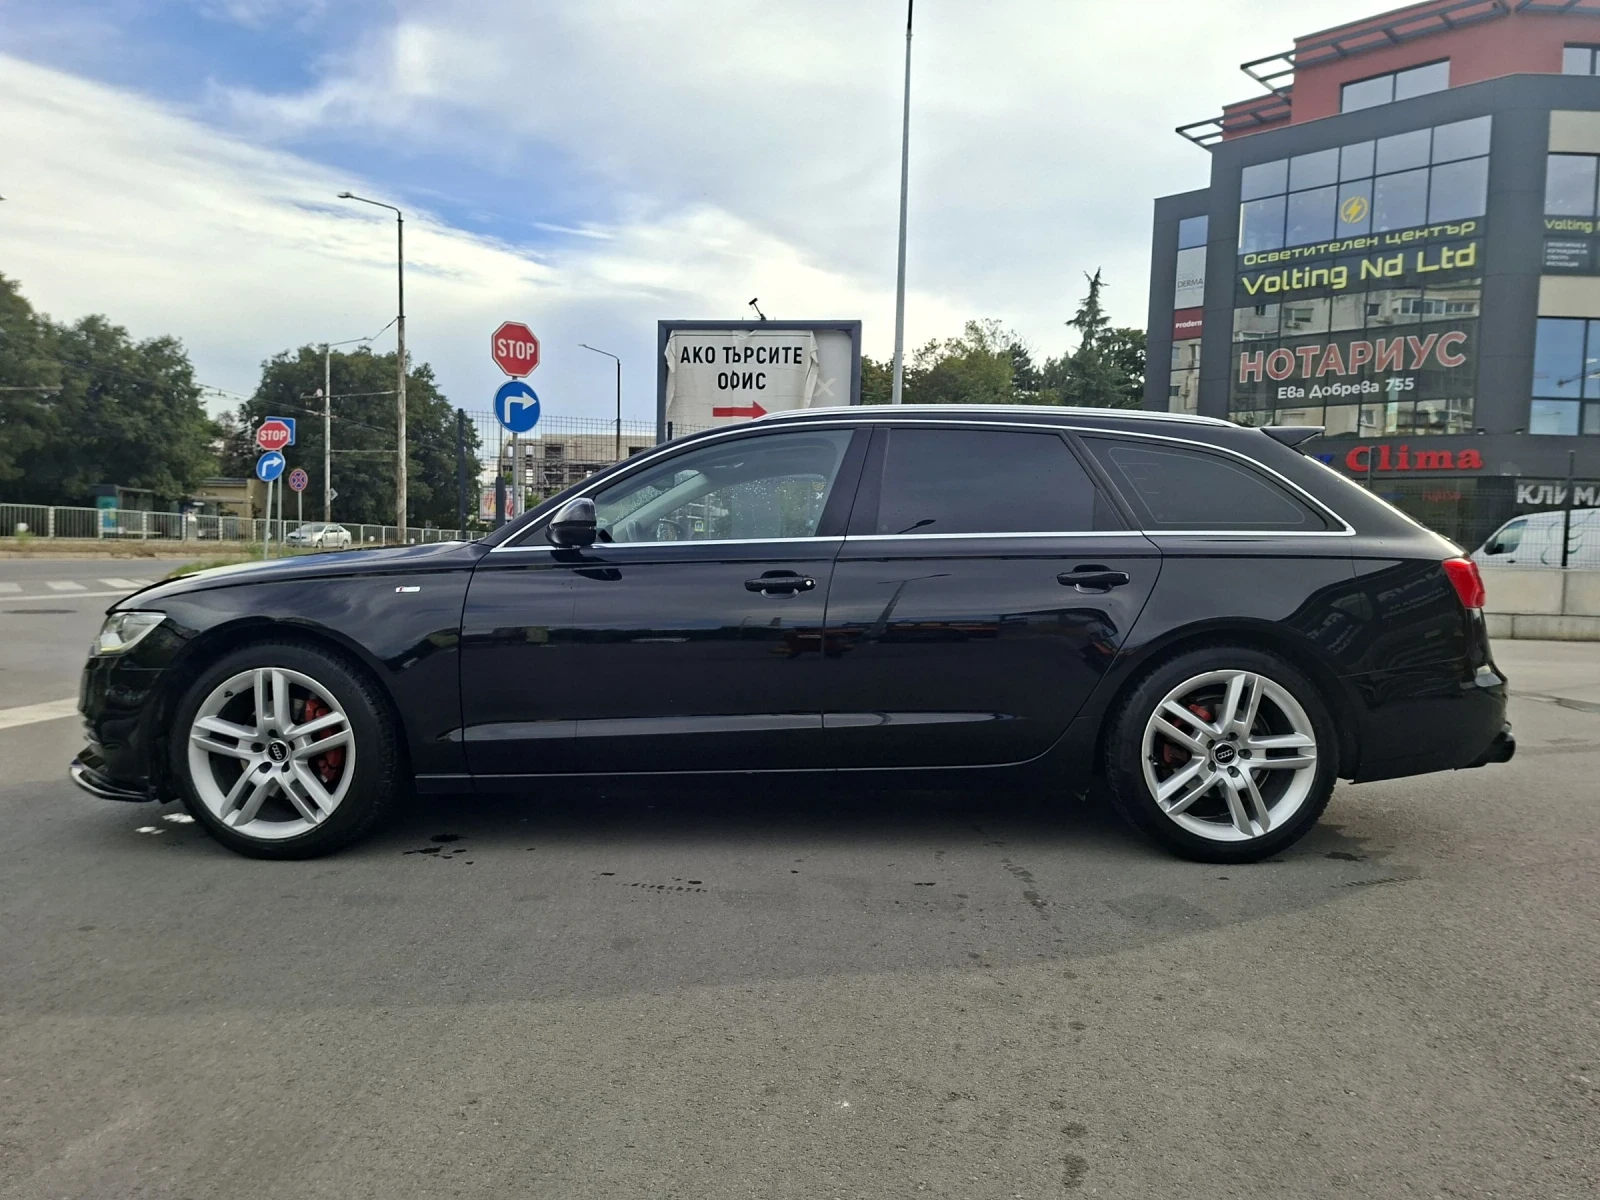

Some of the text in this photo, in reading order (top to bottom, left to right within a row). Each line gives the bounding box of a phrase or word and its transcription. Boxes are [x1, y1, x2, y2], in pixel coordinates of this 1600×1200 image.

[1544, 219, 1593, 234] Volting
[1243, 221, 1477, 266] Осветителен център
[1242, 242, 1476, 295] Volting Nd Ltd
[497, 338, 535, 360] STOP
[680, 346, 802, 364] АКО ТЪРСИТЕ
[1239, 331, 1468, 383] НОТАРИУС
[717, 371, 767, 391] ОФИС
[1277, 377, 1415, 400] Ева Добрева 755
[260, 430, 287, 441] STOP
[1345, 444, 1483, 472] Clima
